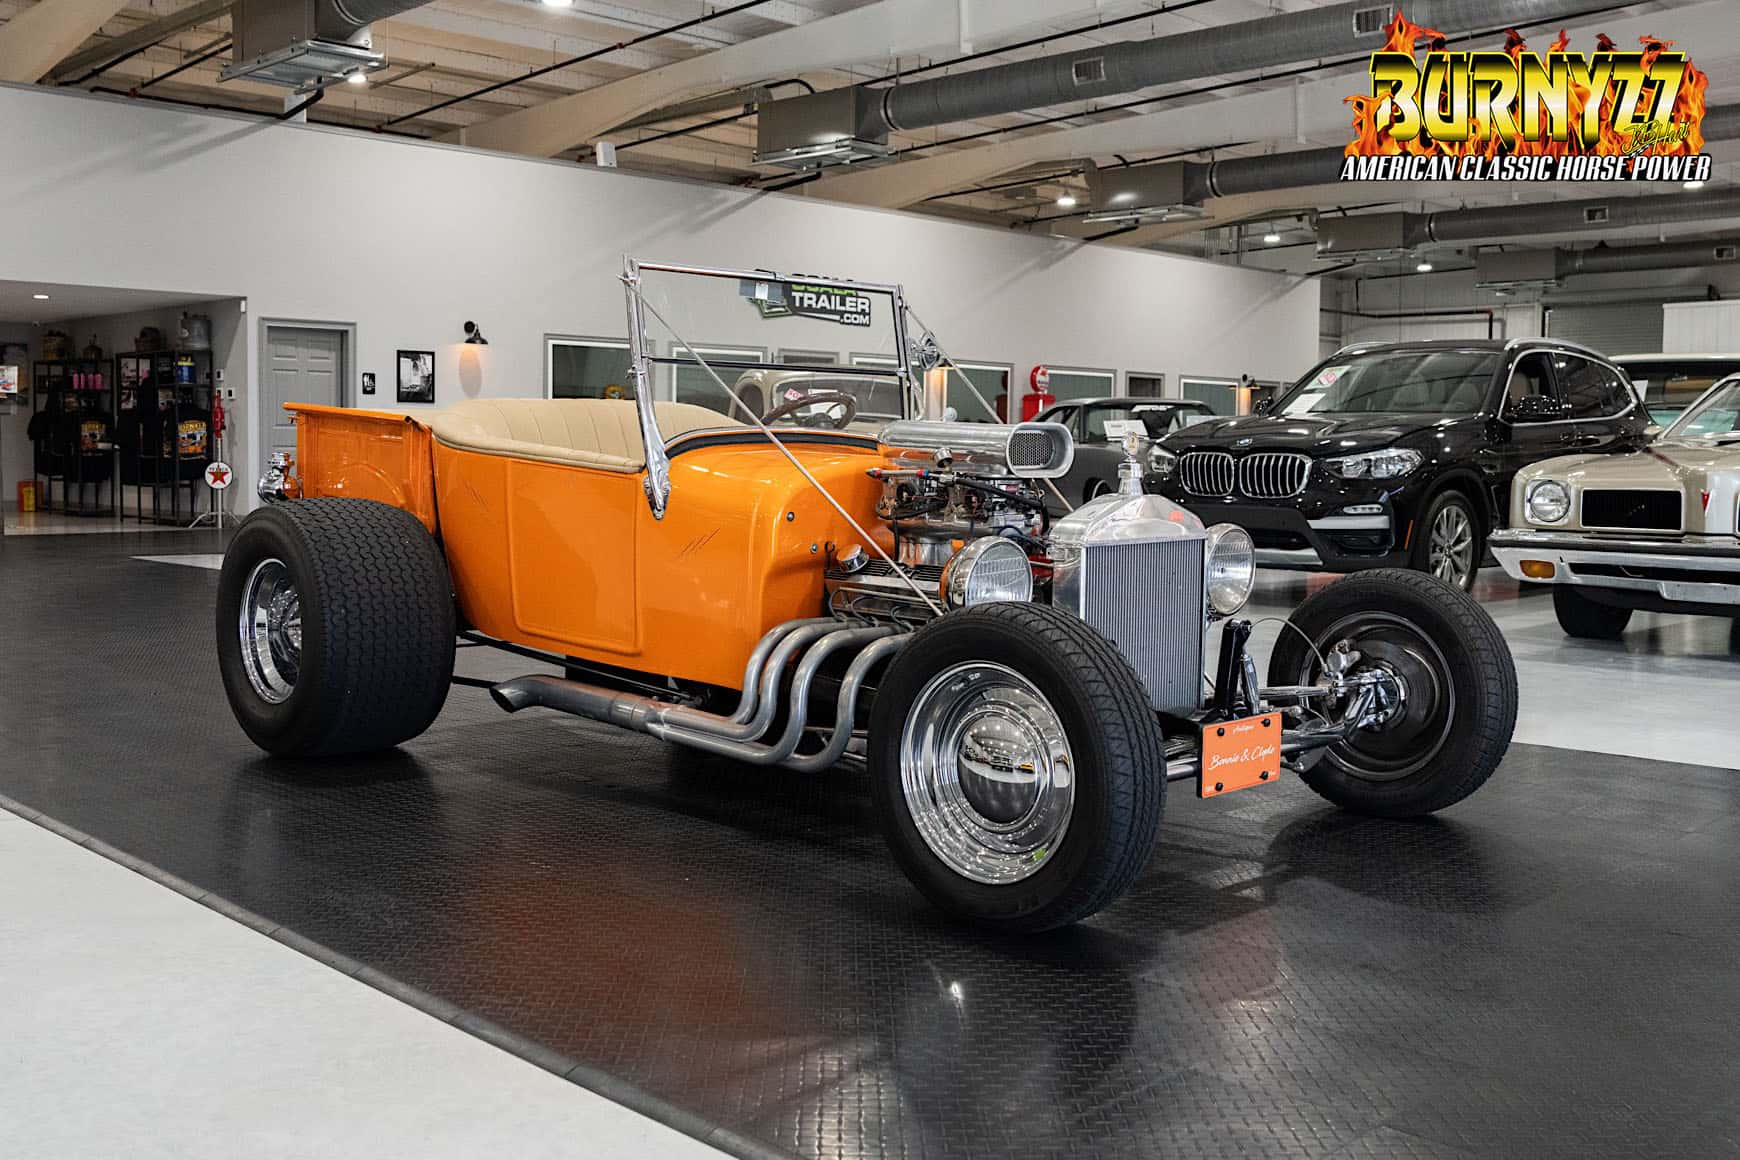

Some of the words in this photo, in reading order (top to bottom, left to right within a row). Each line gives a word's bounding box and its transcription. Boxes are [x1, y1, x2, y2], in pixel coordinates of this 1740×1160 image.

[792, 292, 870, 313] TRAILER
[840, 313, 870, 325] .COM
[1240, 748, 1250, 763] &
